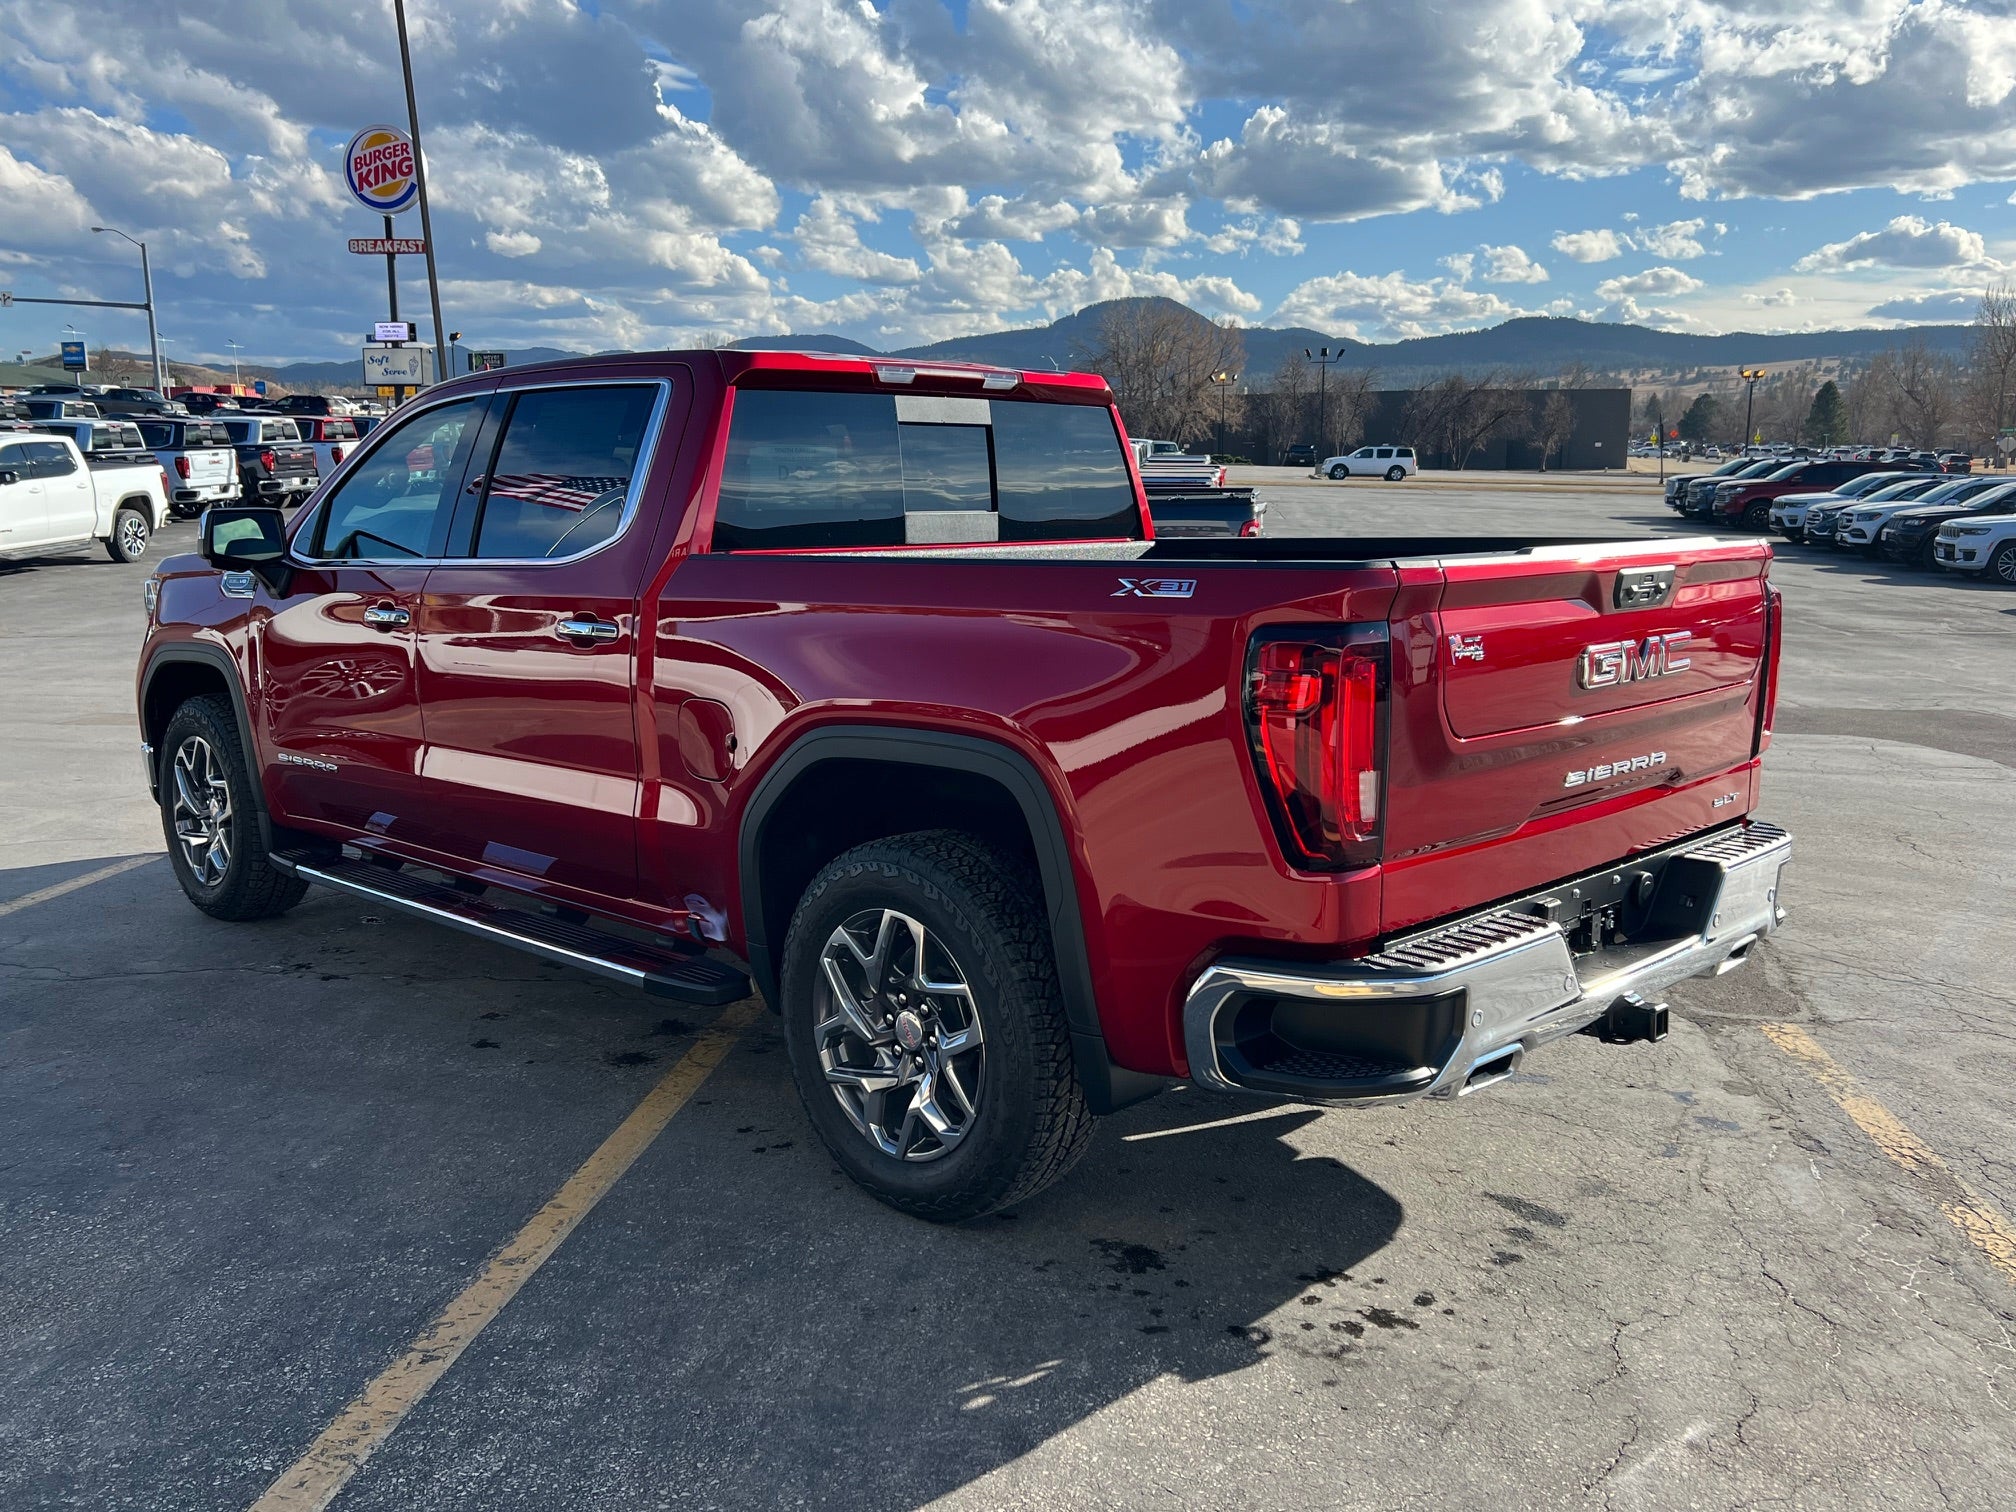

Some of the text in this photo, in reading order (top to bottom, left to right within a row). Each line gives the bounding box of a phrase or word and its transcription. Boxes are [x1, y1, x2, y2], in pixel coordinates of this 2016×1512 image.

[354, 142, 411, 173] BURGER
[357, 156, 414, 193] KING
[349, 240, 425, 253] BREAKFAST
[367, 355, 390, 366] Soft
[382, 367, 408, 376] Serve
[1576, 630, 1692, 690] GMC
[277, 752, 339, 773] SIERRA
[1563, 750, 1667, 788] SIERRA
[1711, 791, 1741, 809] SLT
